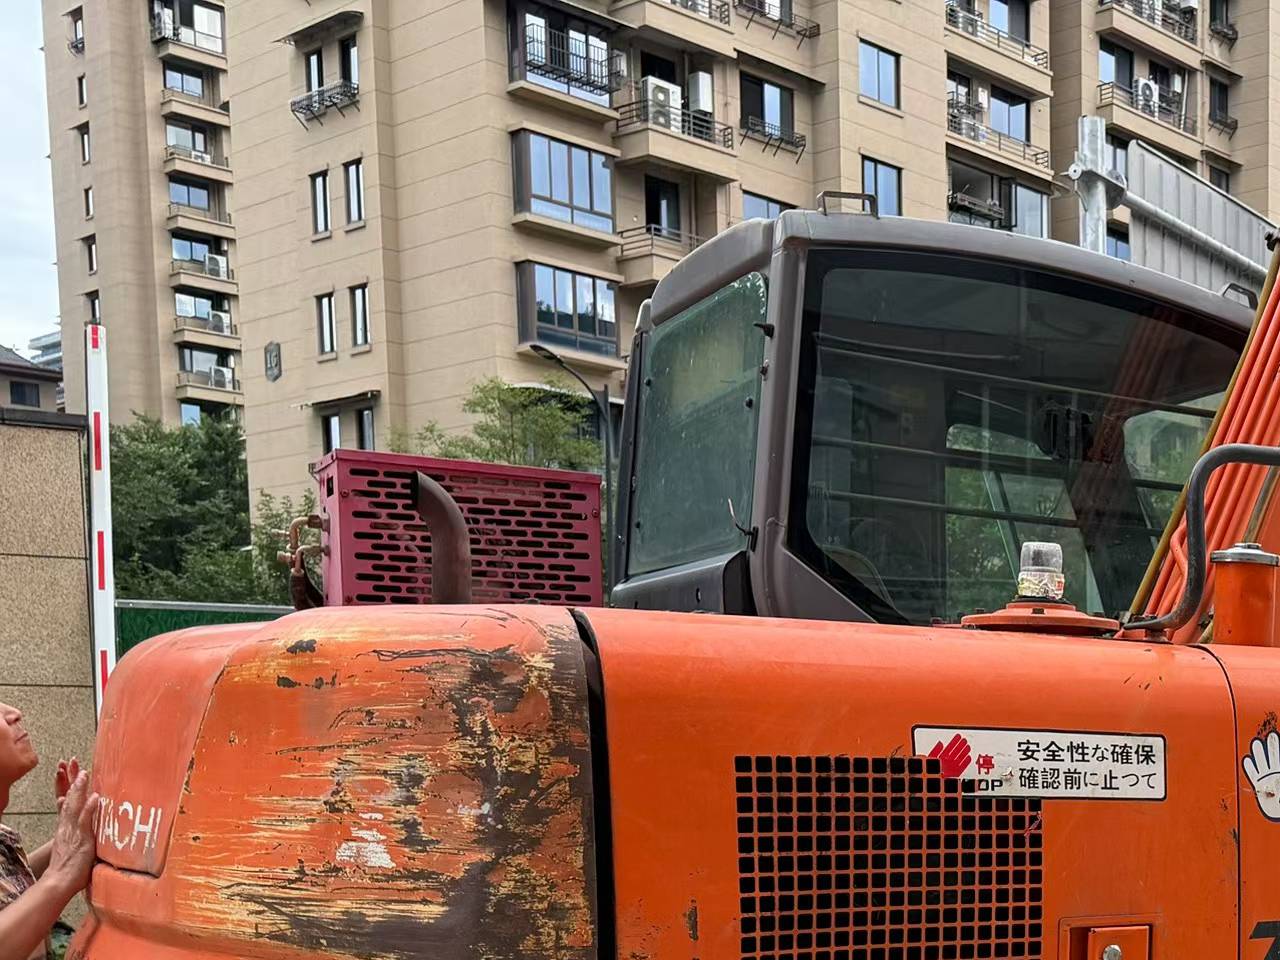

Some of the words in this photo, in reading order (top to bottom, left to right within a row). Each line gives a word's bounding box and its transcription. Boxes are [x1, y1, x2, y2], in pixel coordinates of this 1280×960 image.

[975, 753, 996, 775] 停
[1017, 739, 1156, 766] 安全性な確保
